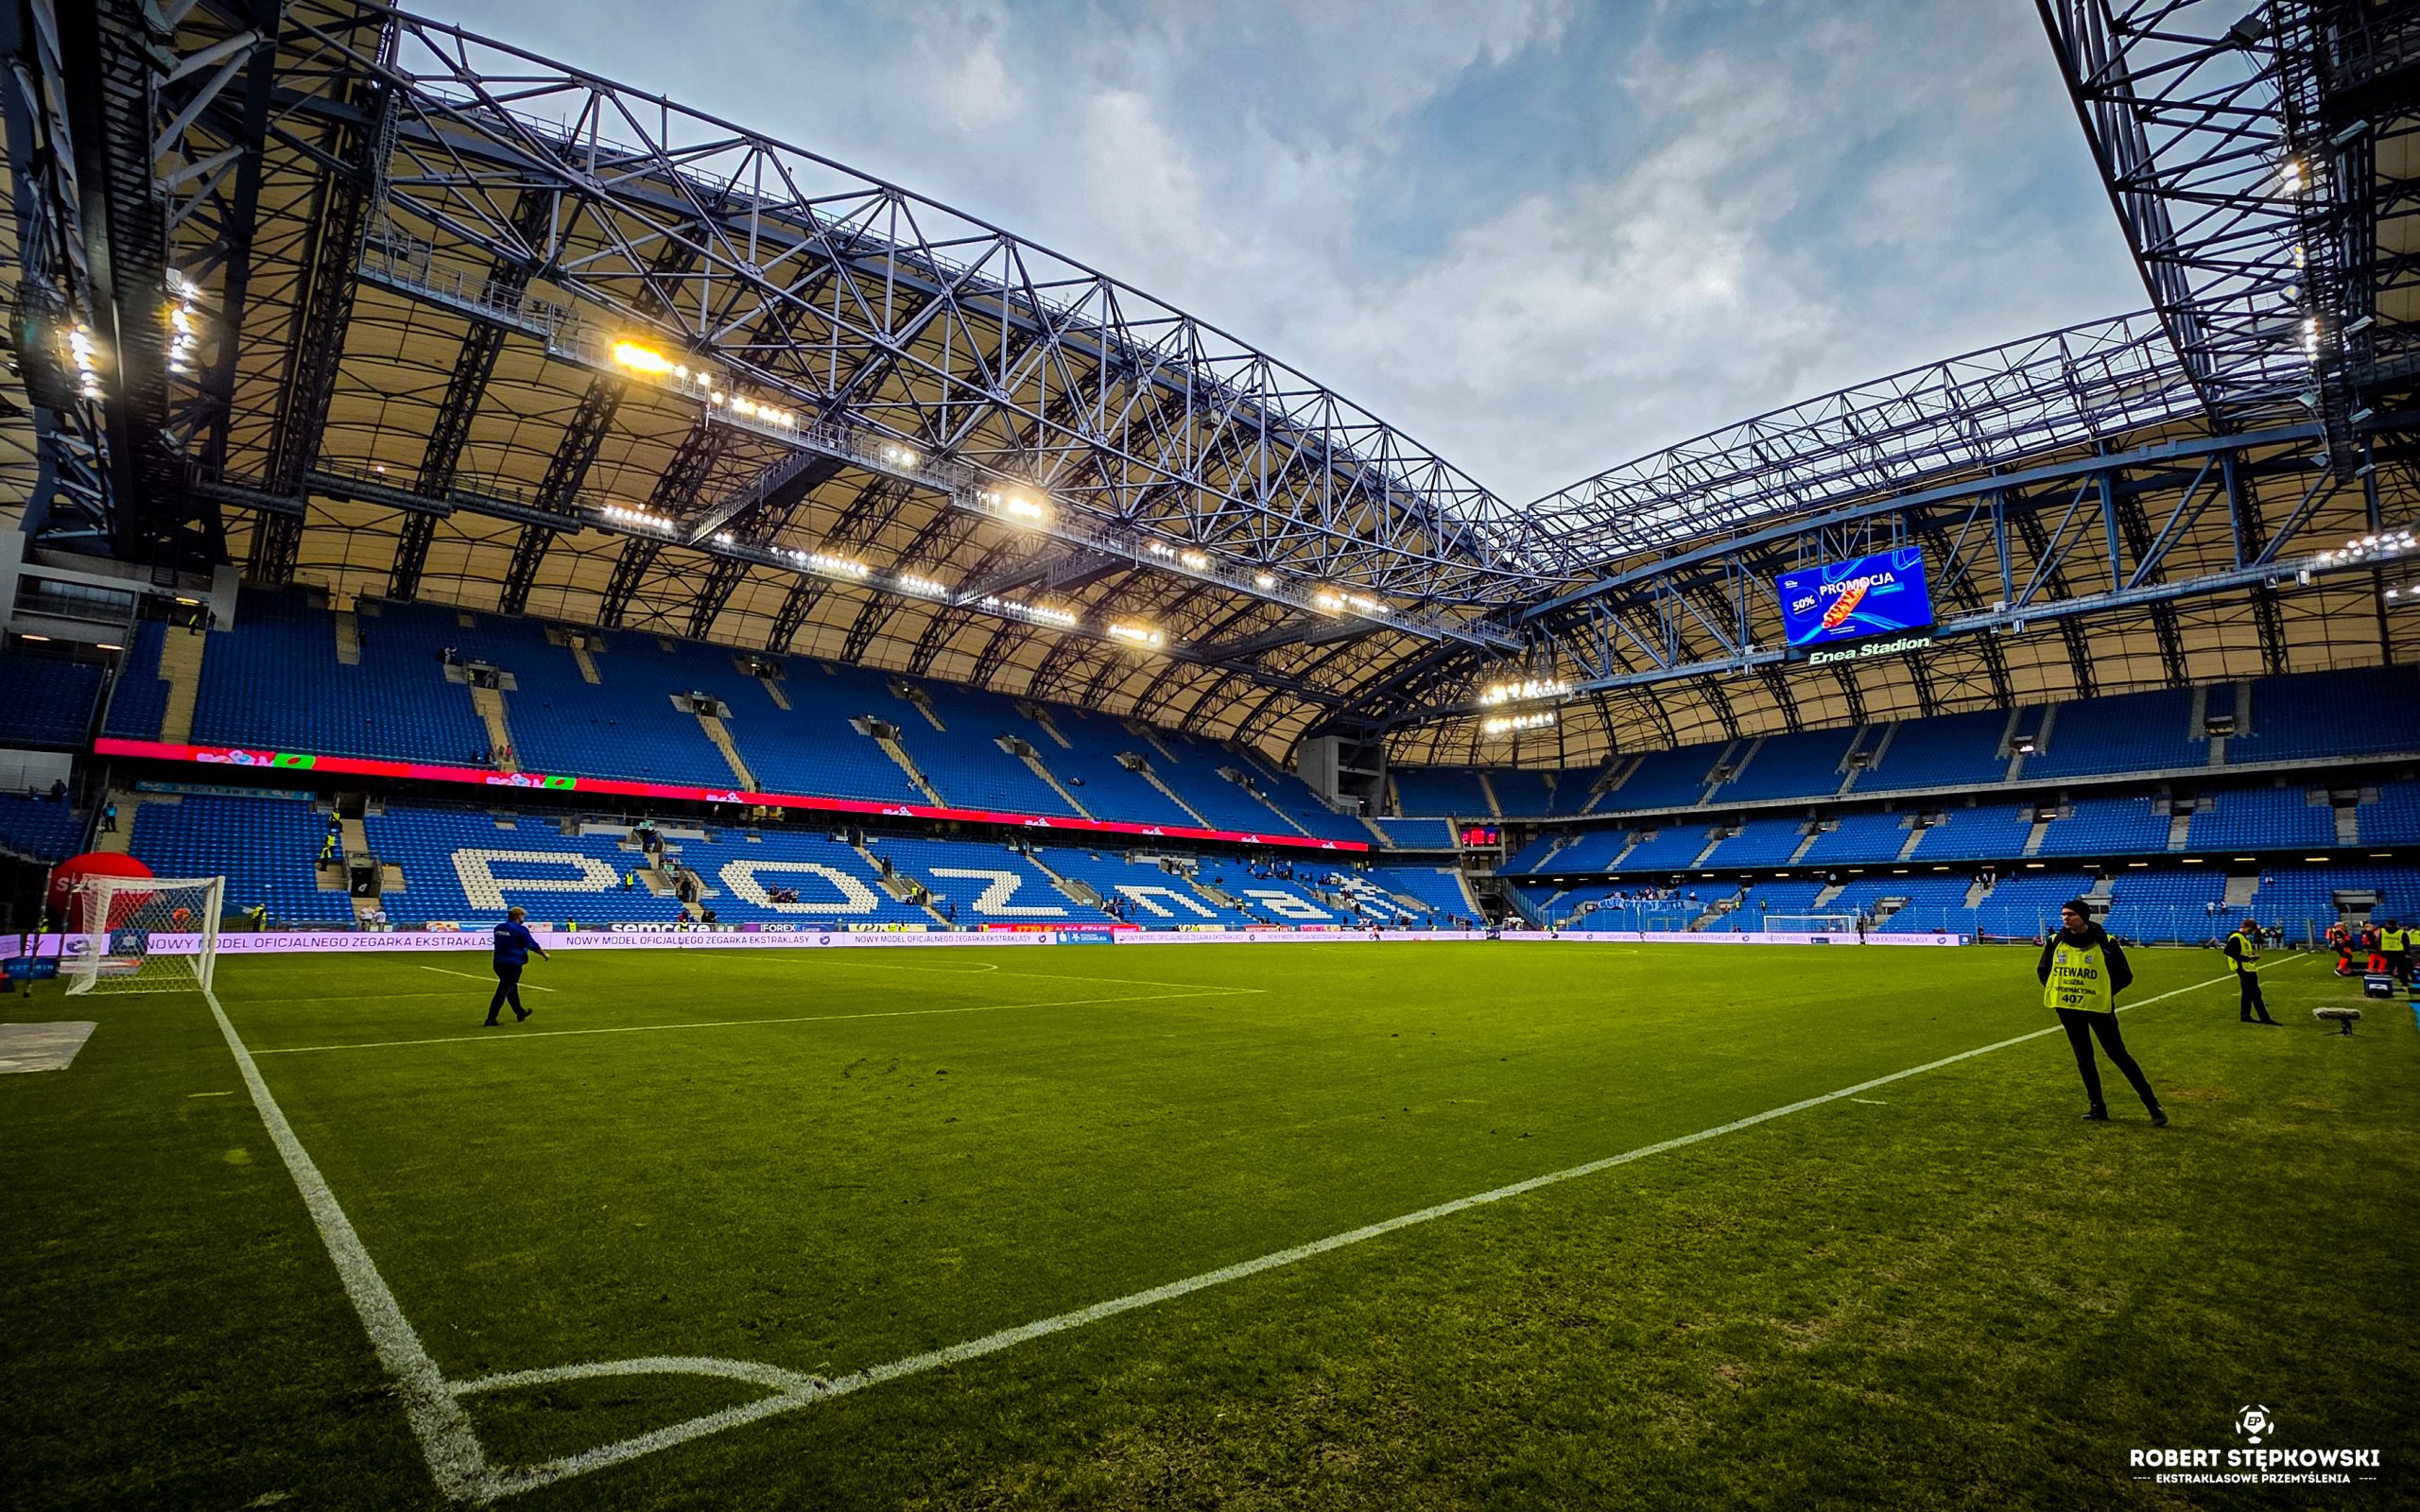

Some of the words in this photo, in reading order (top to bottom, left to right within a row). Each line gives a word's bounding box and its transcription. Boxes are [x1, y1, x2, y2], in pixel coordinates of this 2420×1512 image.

[1820, 572, 1894, 596] PROMOCJA
[1792, 594, 1815, 611] 50%
[1809, 648, 1857, 665] Enea
[1859, 637, 1931, 657] Stadion
[254, 936, 348, 948] OFICJALNEGO
[352, 936, 411, 947] ZEGARKA
[416, 936, 495, 946] EKSTRAKLAS
[567, 936, 599, 945] NOWY
[602, 936, 637, 945] MODEL
[640, 936, 704, 945] OFICJALNEGO
[706, 936, 747, 944] ZEGARKA
[750, 936, 810, 944] EKSTRAKLASY
[880, 935, 906, 943] MODEL
[908, 935, 954, 943] OFICJALNEGO
[955, 935, 985, 943] ZEGARKA
[2054, 967, 2098, 979] STEWARD
[2062, 994, 2083, 1004] 407
